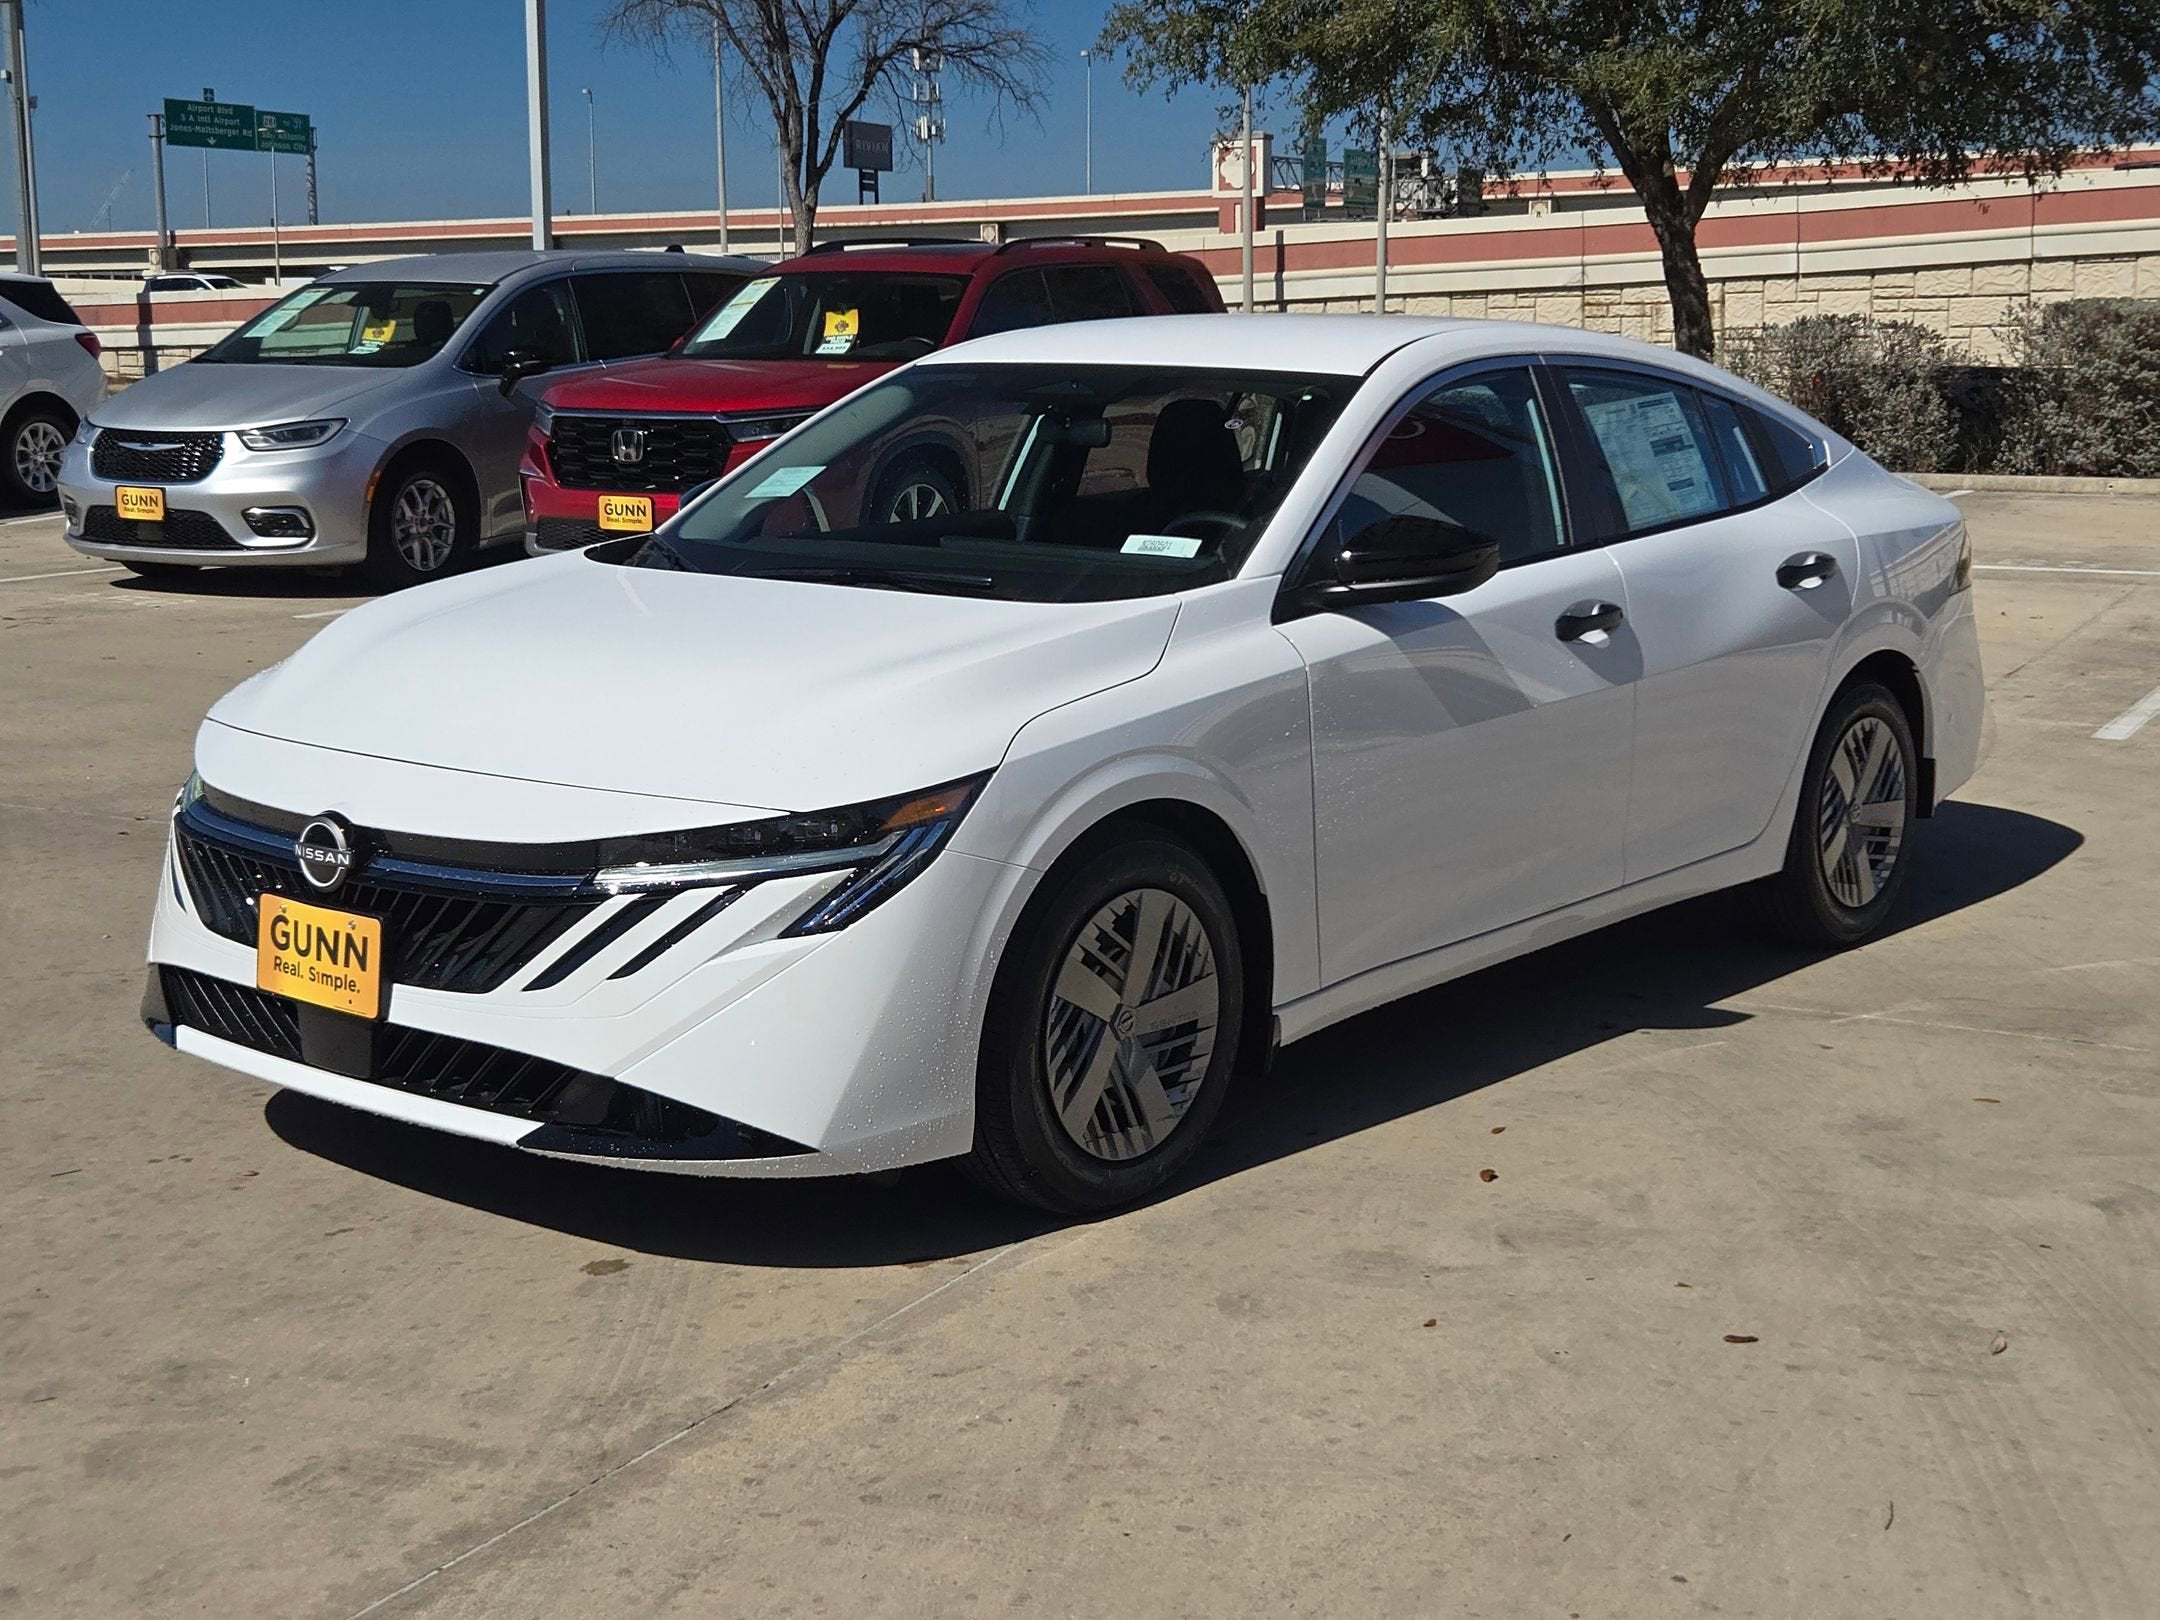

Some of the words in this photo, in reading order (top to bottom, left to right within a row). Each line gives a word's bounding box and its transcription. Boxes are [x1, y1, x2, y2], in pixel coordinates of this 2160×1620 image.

[187, 103, 214, 114] Airport
[216, 106, 234, 115] Blvd
[189, 114, 194, 122] A
[214, 117, 240, 127] Airport
[243, 129, 252, 137] Rd
[121, 494, 158, 506] GUNN
[604, 503, 647, 517] GUNN
[295, 843, 350, 865] NISSAN
[270, 914, 369, 972] GUNN
[273, 955, 304, 979] Real.
